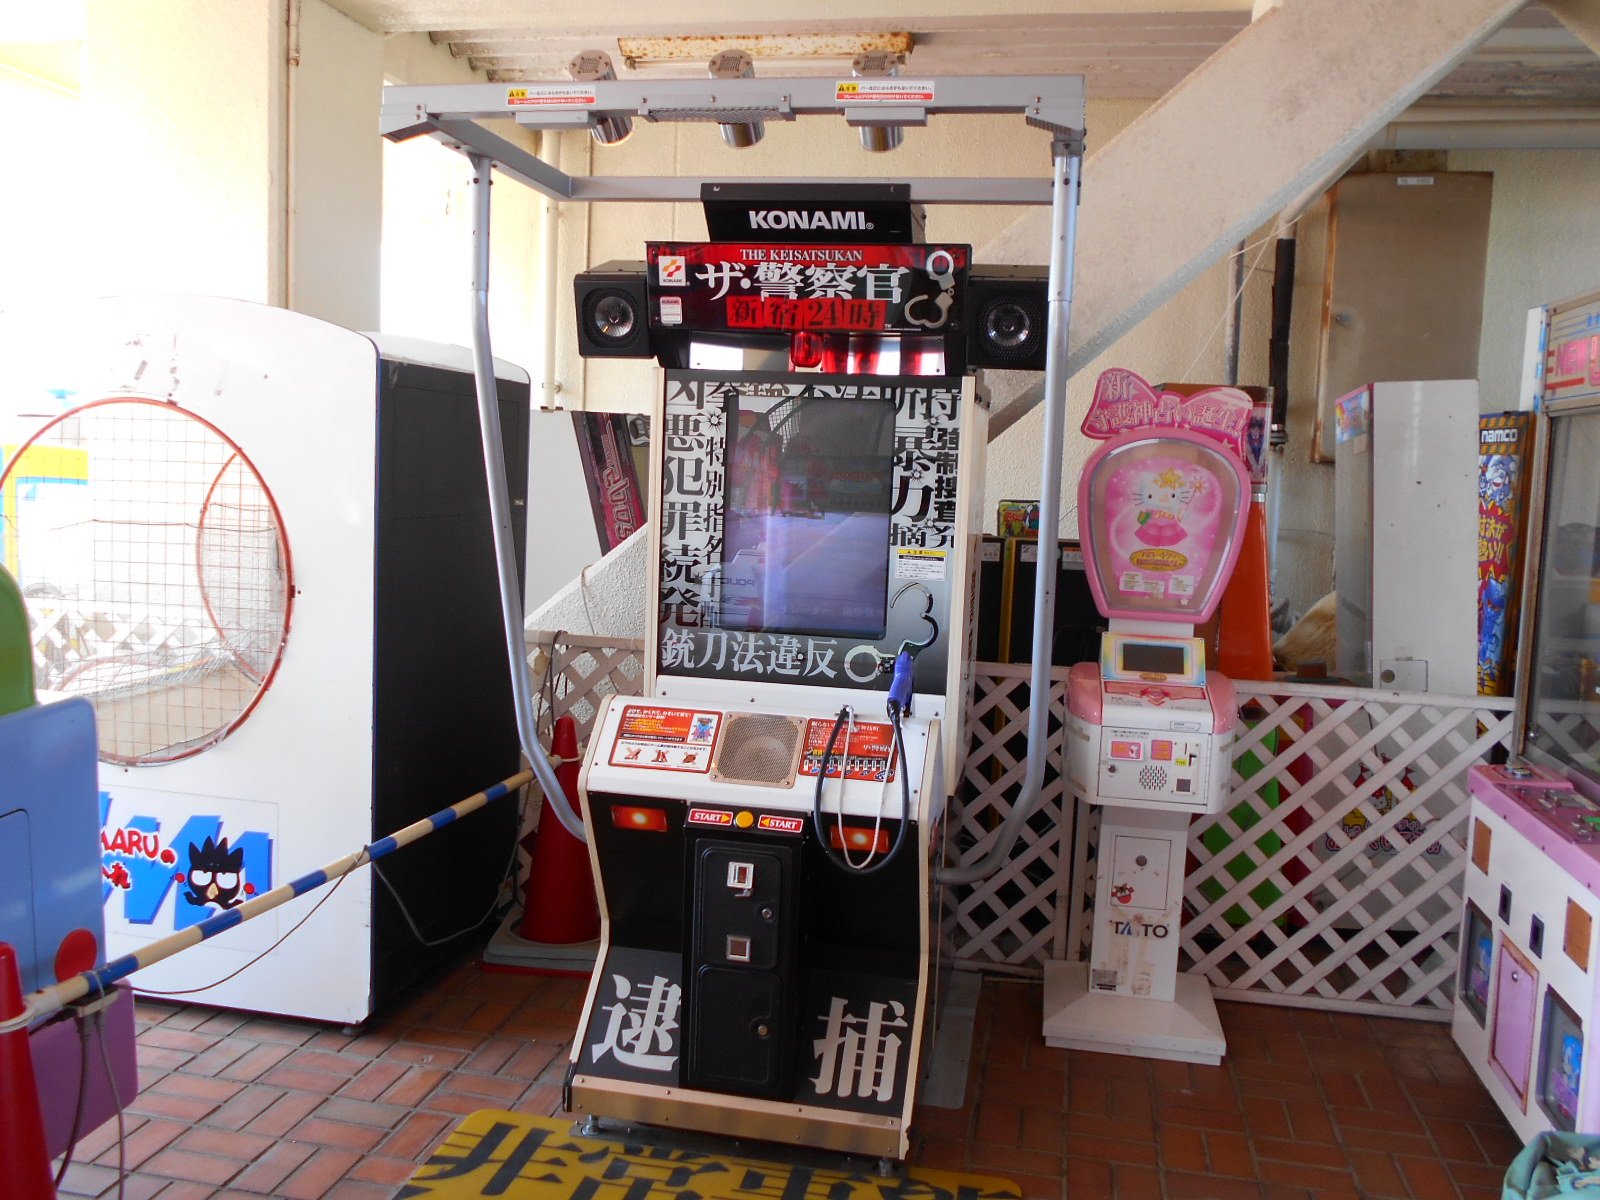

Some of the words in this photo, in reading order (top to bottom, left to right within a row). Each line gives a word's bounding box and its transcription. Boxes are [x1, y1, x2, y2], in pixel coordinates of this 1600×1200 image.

[749, 210, 866, 231] KONAMI
[740, 249, 768, 261] THE
[770, 249, 863, 262] KEISATSUKAN
[694, 261, 910, 304] ザ・警察官
[730, 300, 882, 328] 新宿24時
[1481, 428, 1518, 444] namco
[661, 627, 839, 680] 銃刀法違反
[693, 812, 721, 823] START
[769, 817, 798, 829] START
[1112, 920, 1170, 939] TATO
[591, 974, 682, 1072] 逮
[808, 996, 908, 1102] 捕
